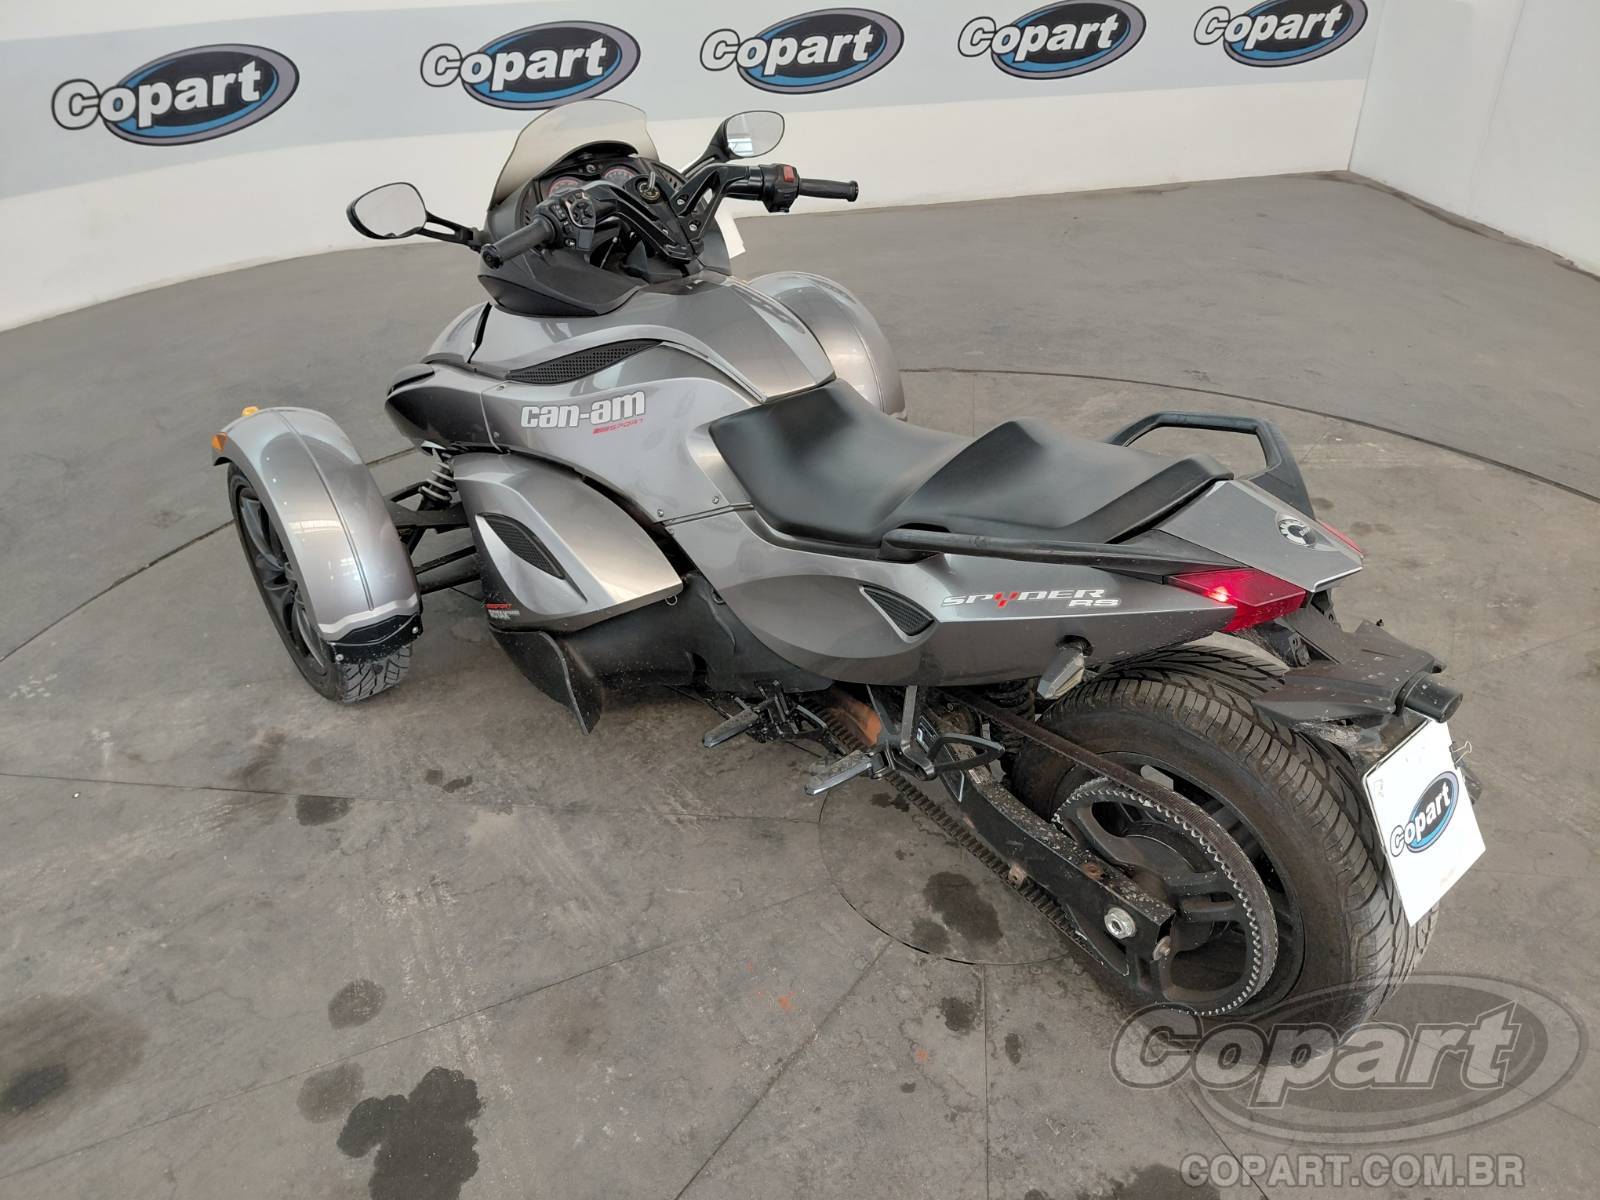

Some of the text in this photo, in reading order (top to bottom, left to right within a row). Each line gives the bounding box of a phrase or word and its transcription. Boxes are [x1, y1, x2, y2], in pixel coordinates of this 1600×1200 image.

[701, 24, 873, 75] Copart
[959, 13, 1119, 62] Copart
[1195, 4, 1344, 48] Copart
[422, 40, 608, 90] Copart
[54, 60, 261, 129] Copart
[520, 391, 645, 428] can-am
[943, 589, 1105, 608] SPYDER
[1067, 598, 1120, 608] RS
[1390, 782, 1450, 857] Copart
